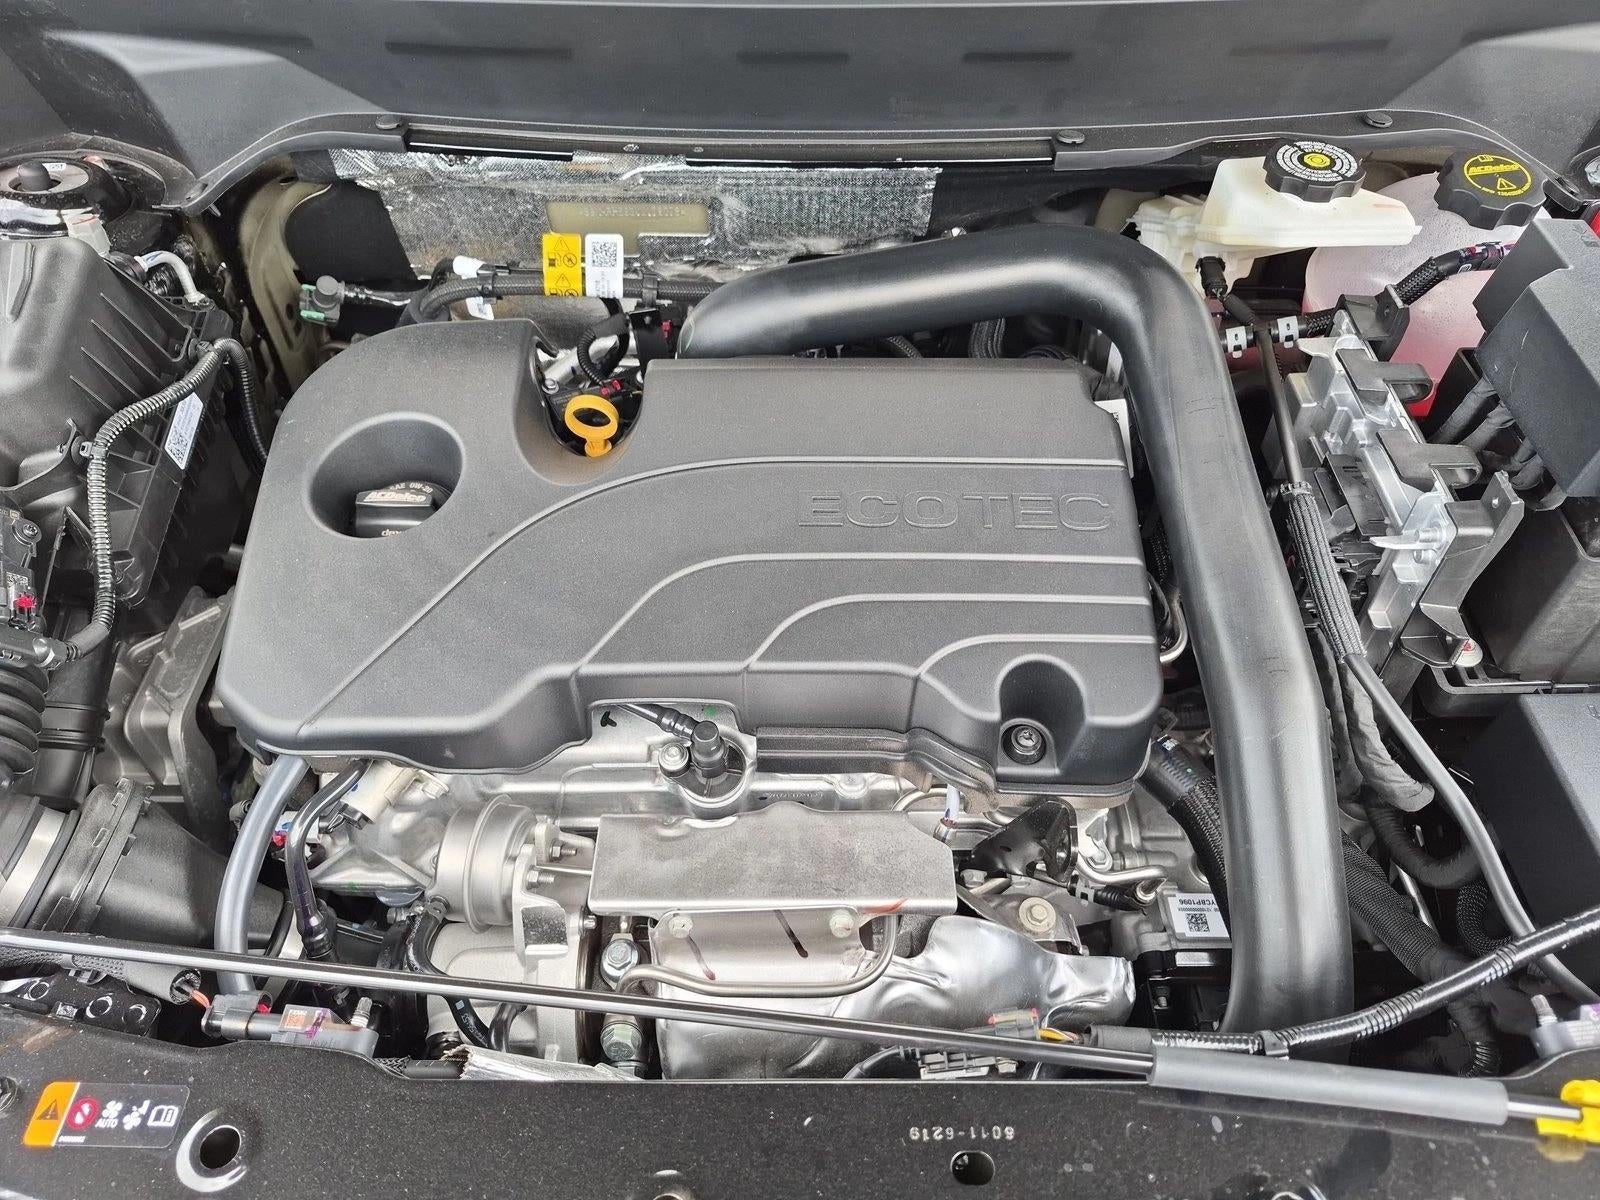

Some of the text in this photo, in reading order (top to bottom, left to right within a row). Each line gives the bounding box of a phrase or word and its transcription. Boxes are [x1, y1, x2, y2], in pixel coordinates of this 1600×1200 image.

[1469, 163, 1521, 175] ACDelco
[409, 482, 433, 494] 0W-20
[363, 491, 427, 503] ACDelco
[798, 490, 1110, 530] ECOTEC
[95, 1118, 118, 1128] AUTO
